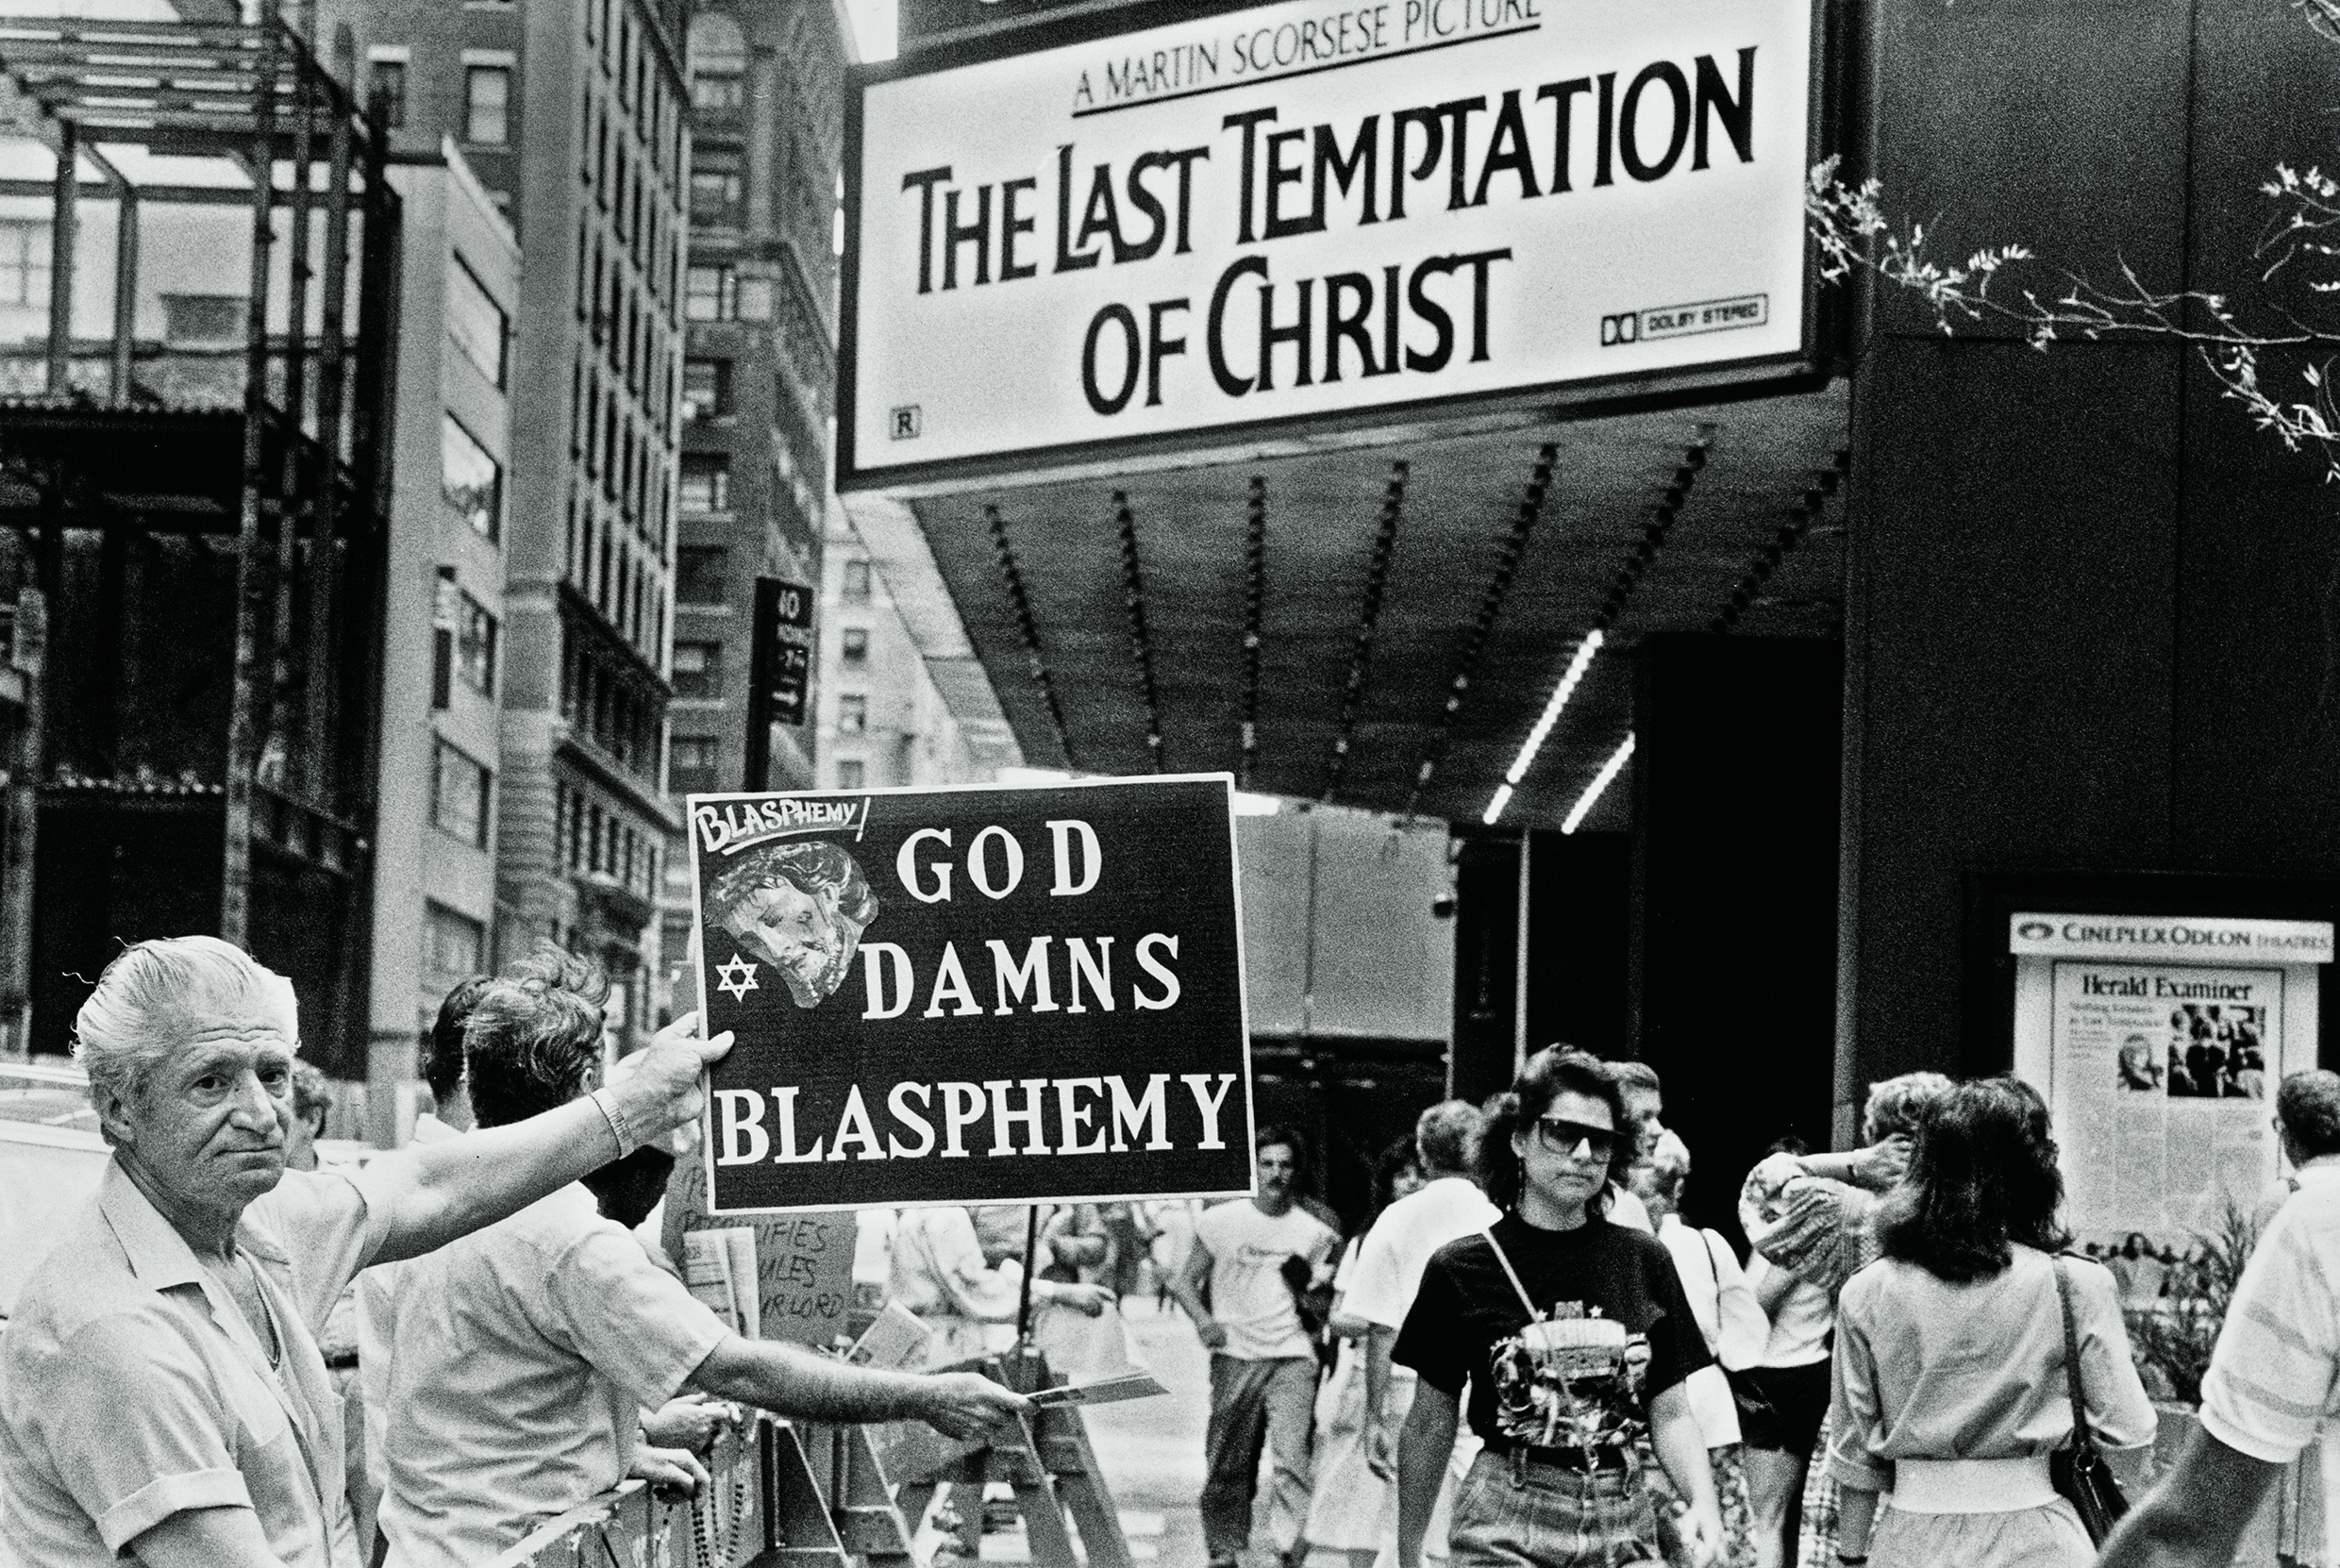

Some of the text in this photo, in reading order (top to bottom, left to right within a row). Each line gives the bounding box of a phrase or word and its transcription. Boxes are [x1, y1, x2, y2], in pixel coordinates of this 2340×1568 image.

[1076, 72, 1095, 106] A
[1106, 40, 1220, 99] MARTIN
[1231, 4, 1390, 75] SCORSESE
[901, 45, 1758, 295] THE LAST TEMPTATION
[1081, 247, 1513, 416] OF CHRIST
[897, 412, 913, 434] R
[895, 819, 1102, 904] GOD
[858, 932, 1181, 1021] DAMNS
[2062, 922, 2167, 943] CINEPLEX
[2170, 923, 2251, 946] ODEON
[2082, 974, 2253, 1001] Herald Examiner
[712, 1073, 1237, 1167] BLASPHEMY
[789, 1293, 844, 1320] LORD
